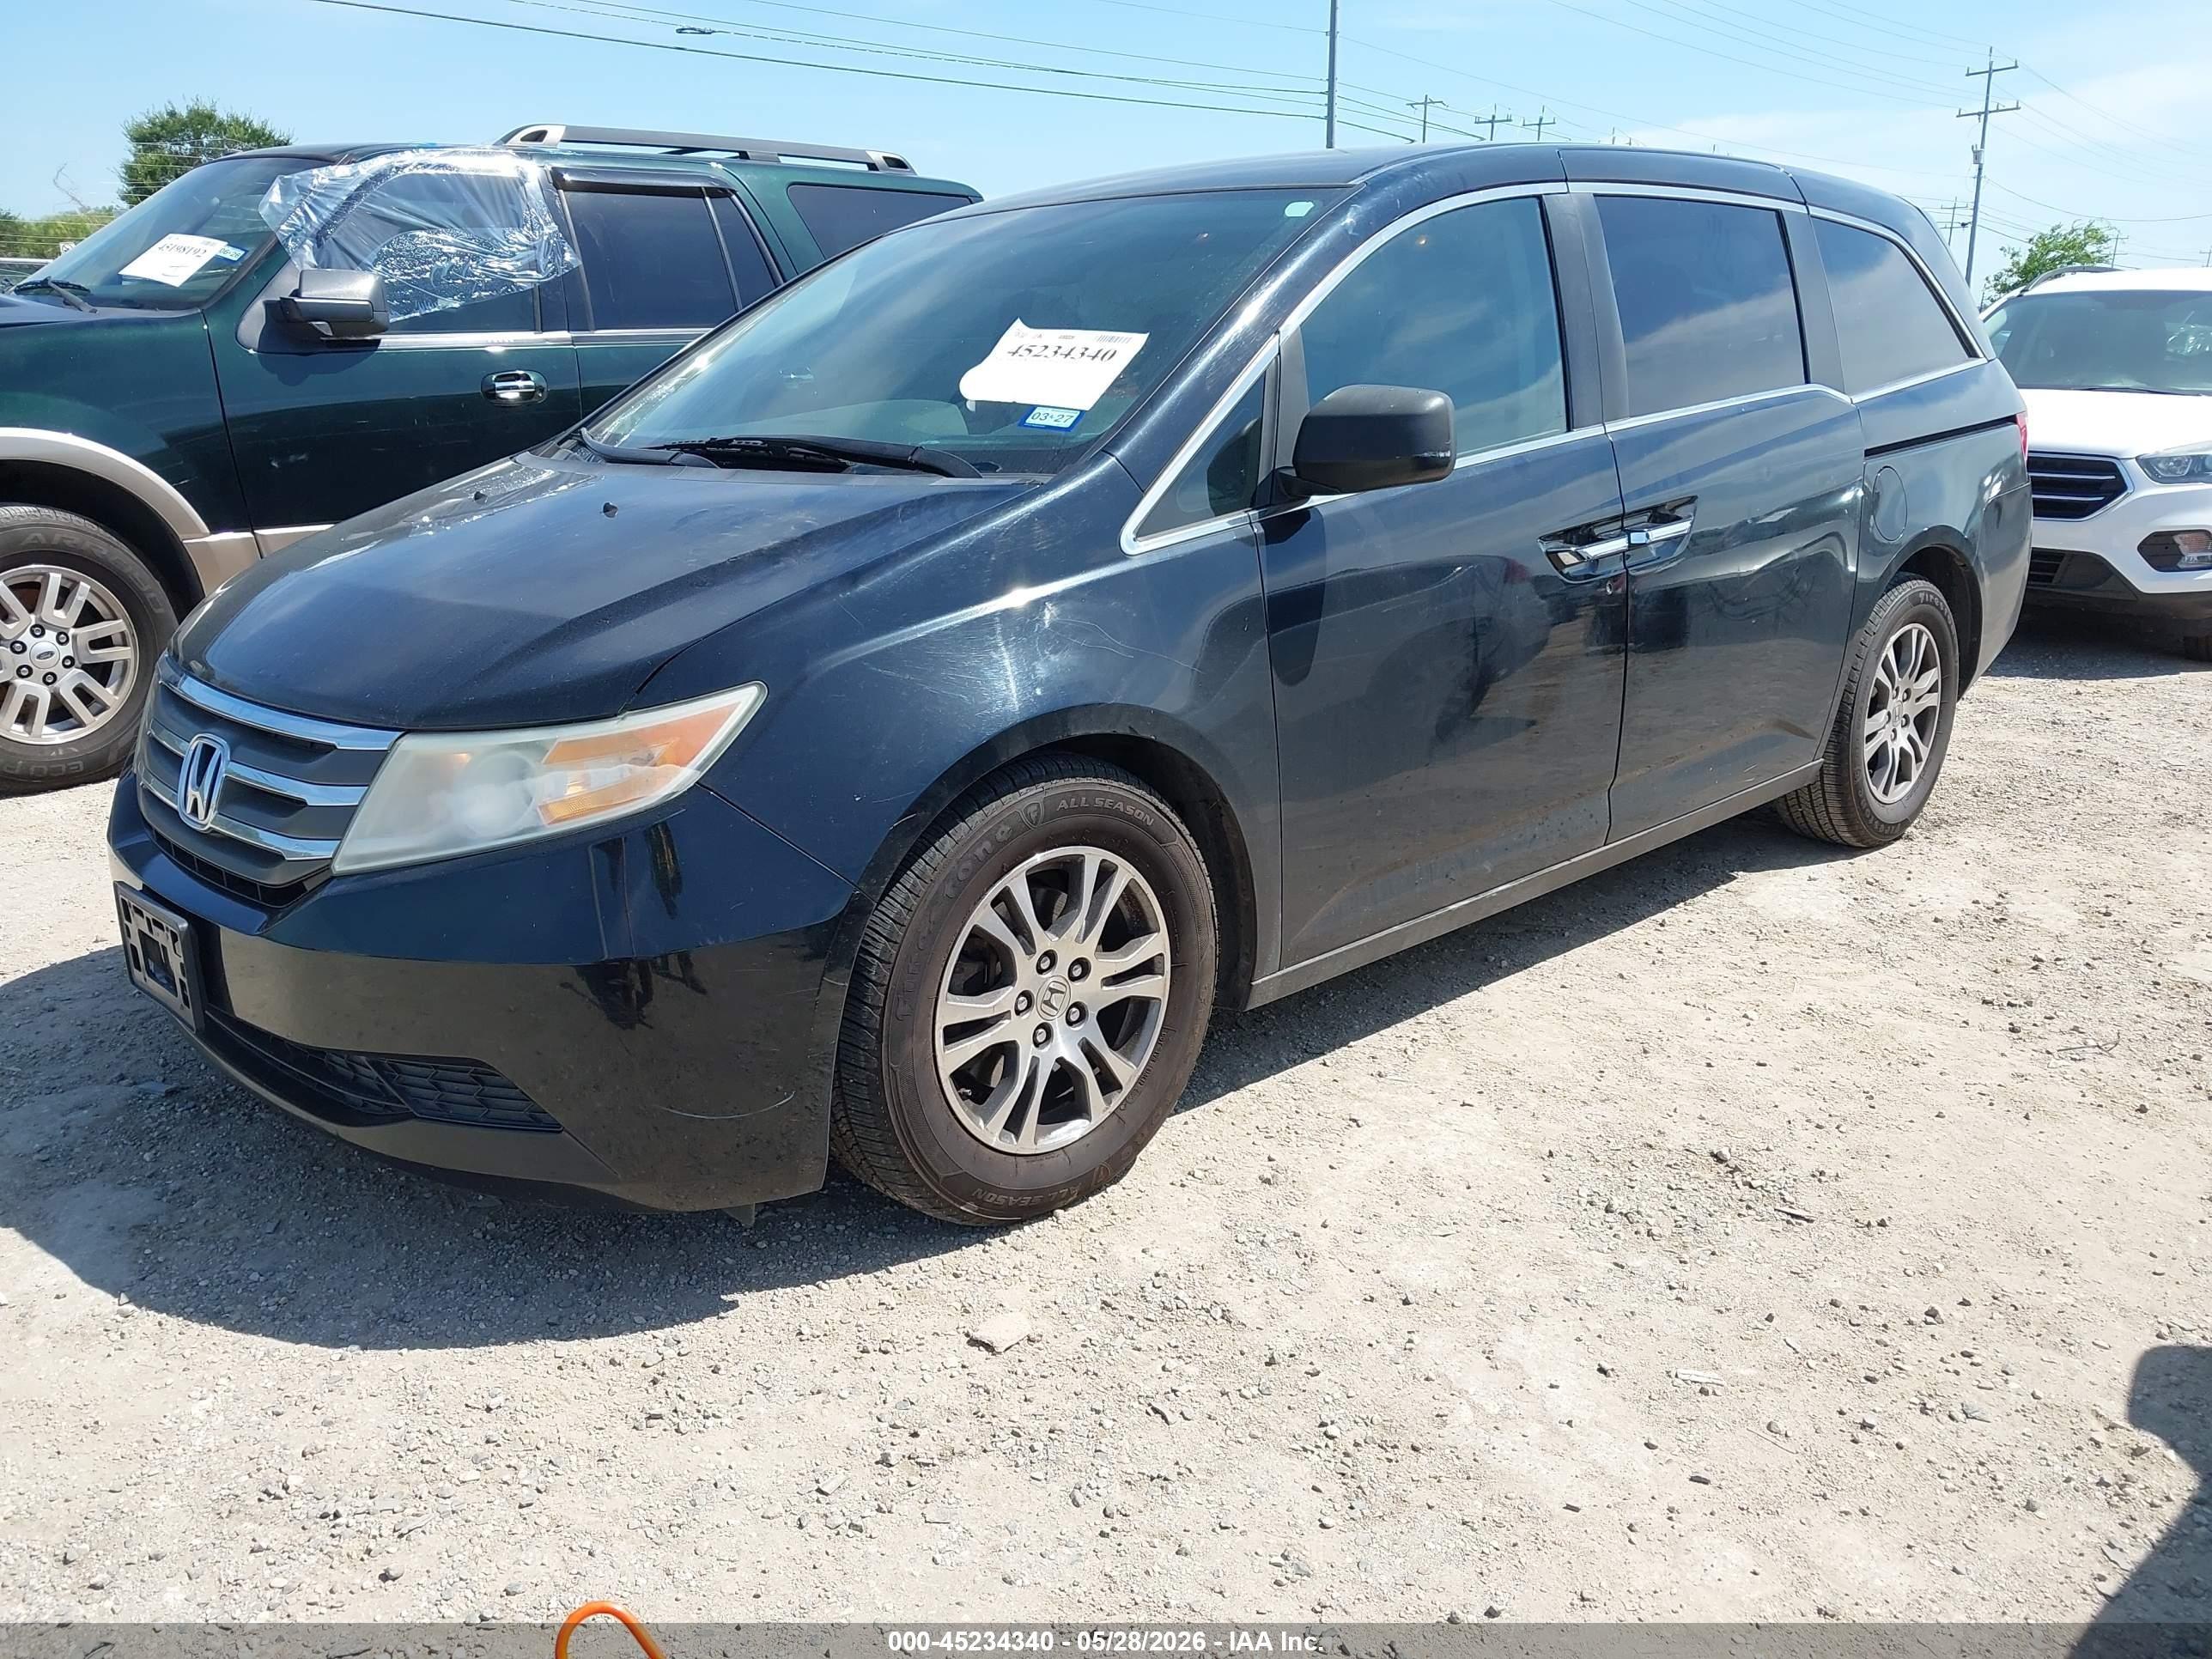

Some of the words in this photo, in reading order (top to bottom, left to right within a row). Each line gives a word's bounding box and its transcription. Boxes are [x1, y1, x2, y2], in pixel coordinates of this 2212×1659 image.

[1006, 343, 1118, 362] 45234340
[1056, 797, 1089, 811] ALL
[1093, 797, 1154, 826] SEASON
